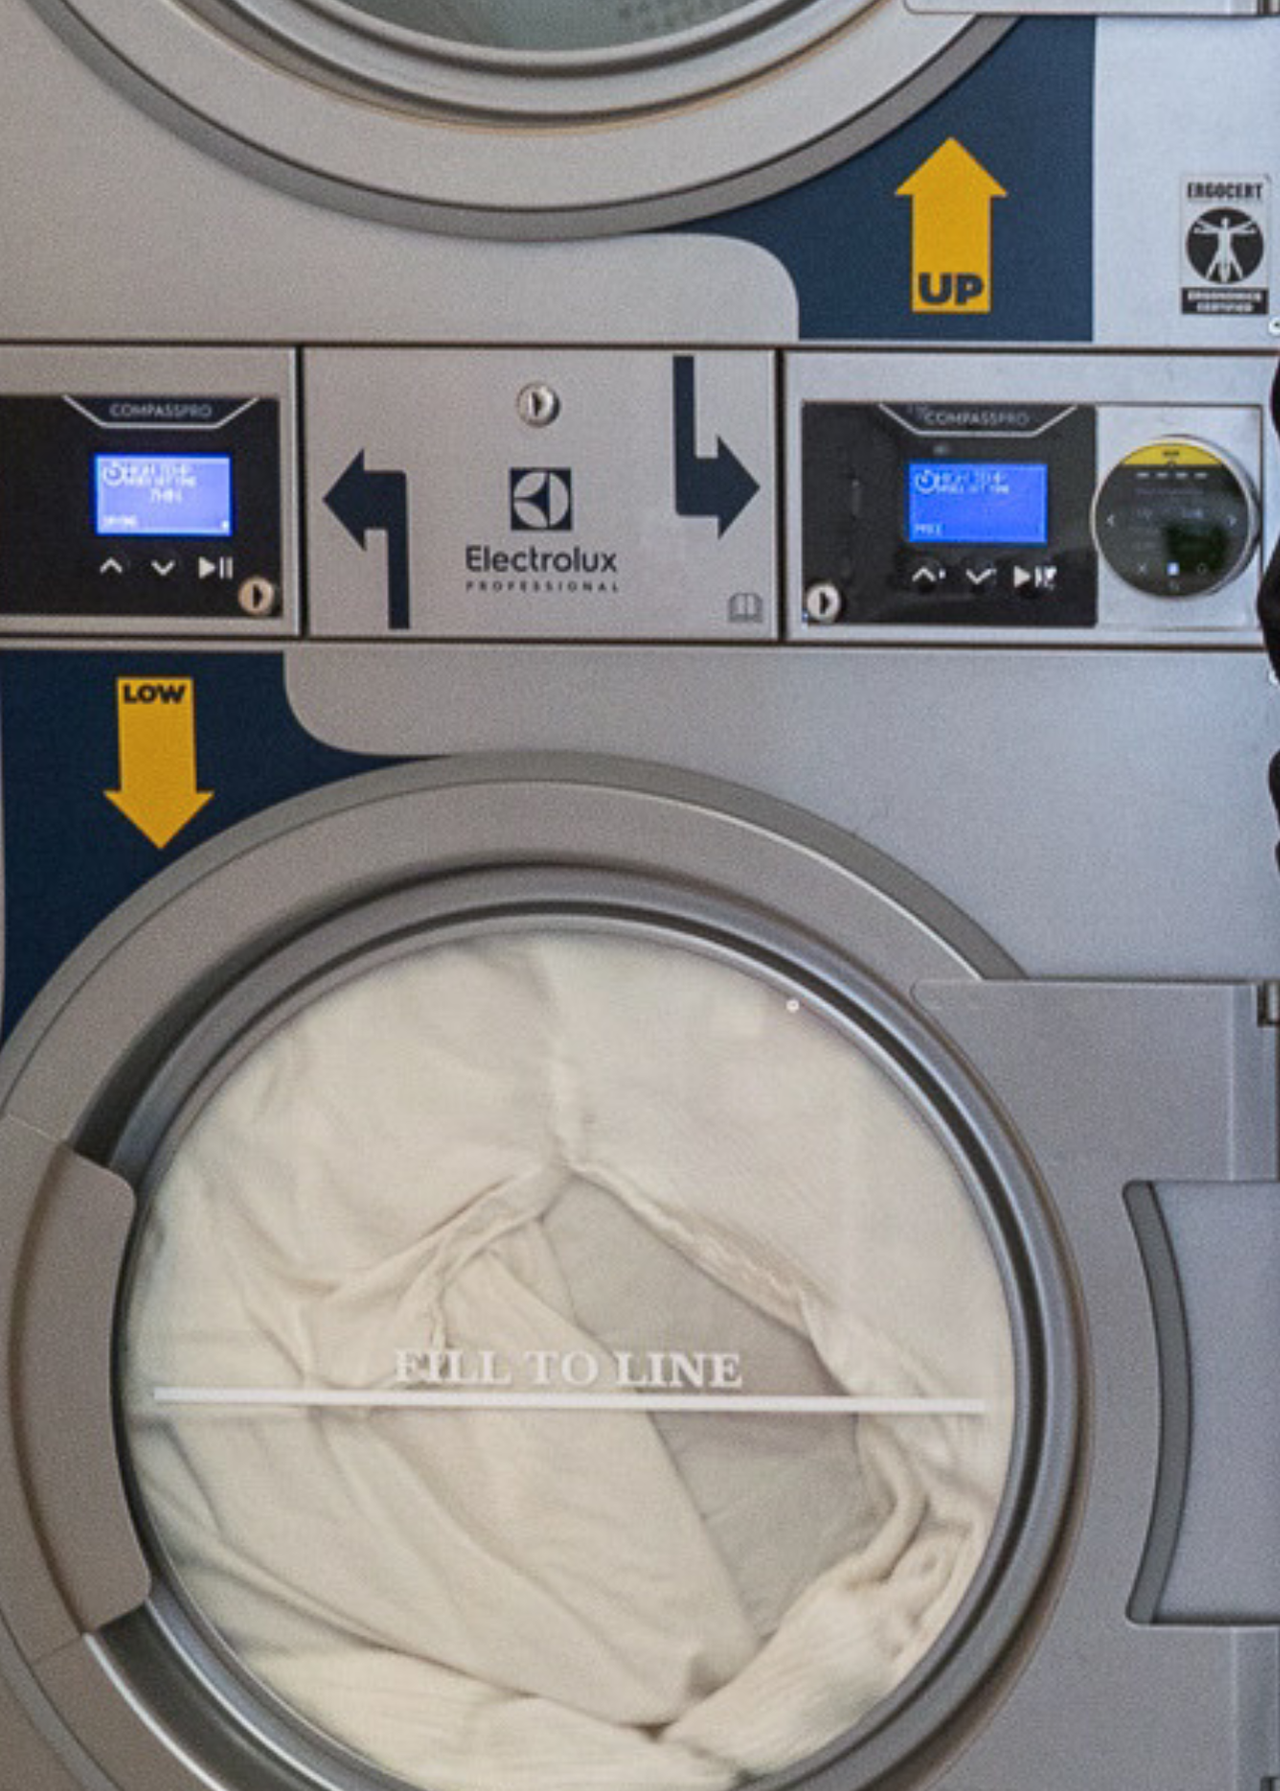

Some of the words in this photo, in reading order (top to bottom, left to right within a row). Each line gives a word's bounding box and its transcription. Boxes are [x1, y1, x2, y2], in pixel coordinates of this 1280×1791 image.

[1187, 182, 1264, 199] ERGOCERT
[918, 271, 985, 306] UP
[109, 402, 214, 419] COMPASSPRO
[465, 544, 618, 574] Electrolux
[465, 580, 620, 593] PROFESSIONAL
[122, 684, 186, 705] LOW
[395, 1349, 511, 1386] FILL
[524, 1351, 599, 1387] TO
[613, 1353, 742, 1389] LINE
